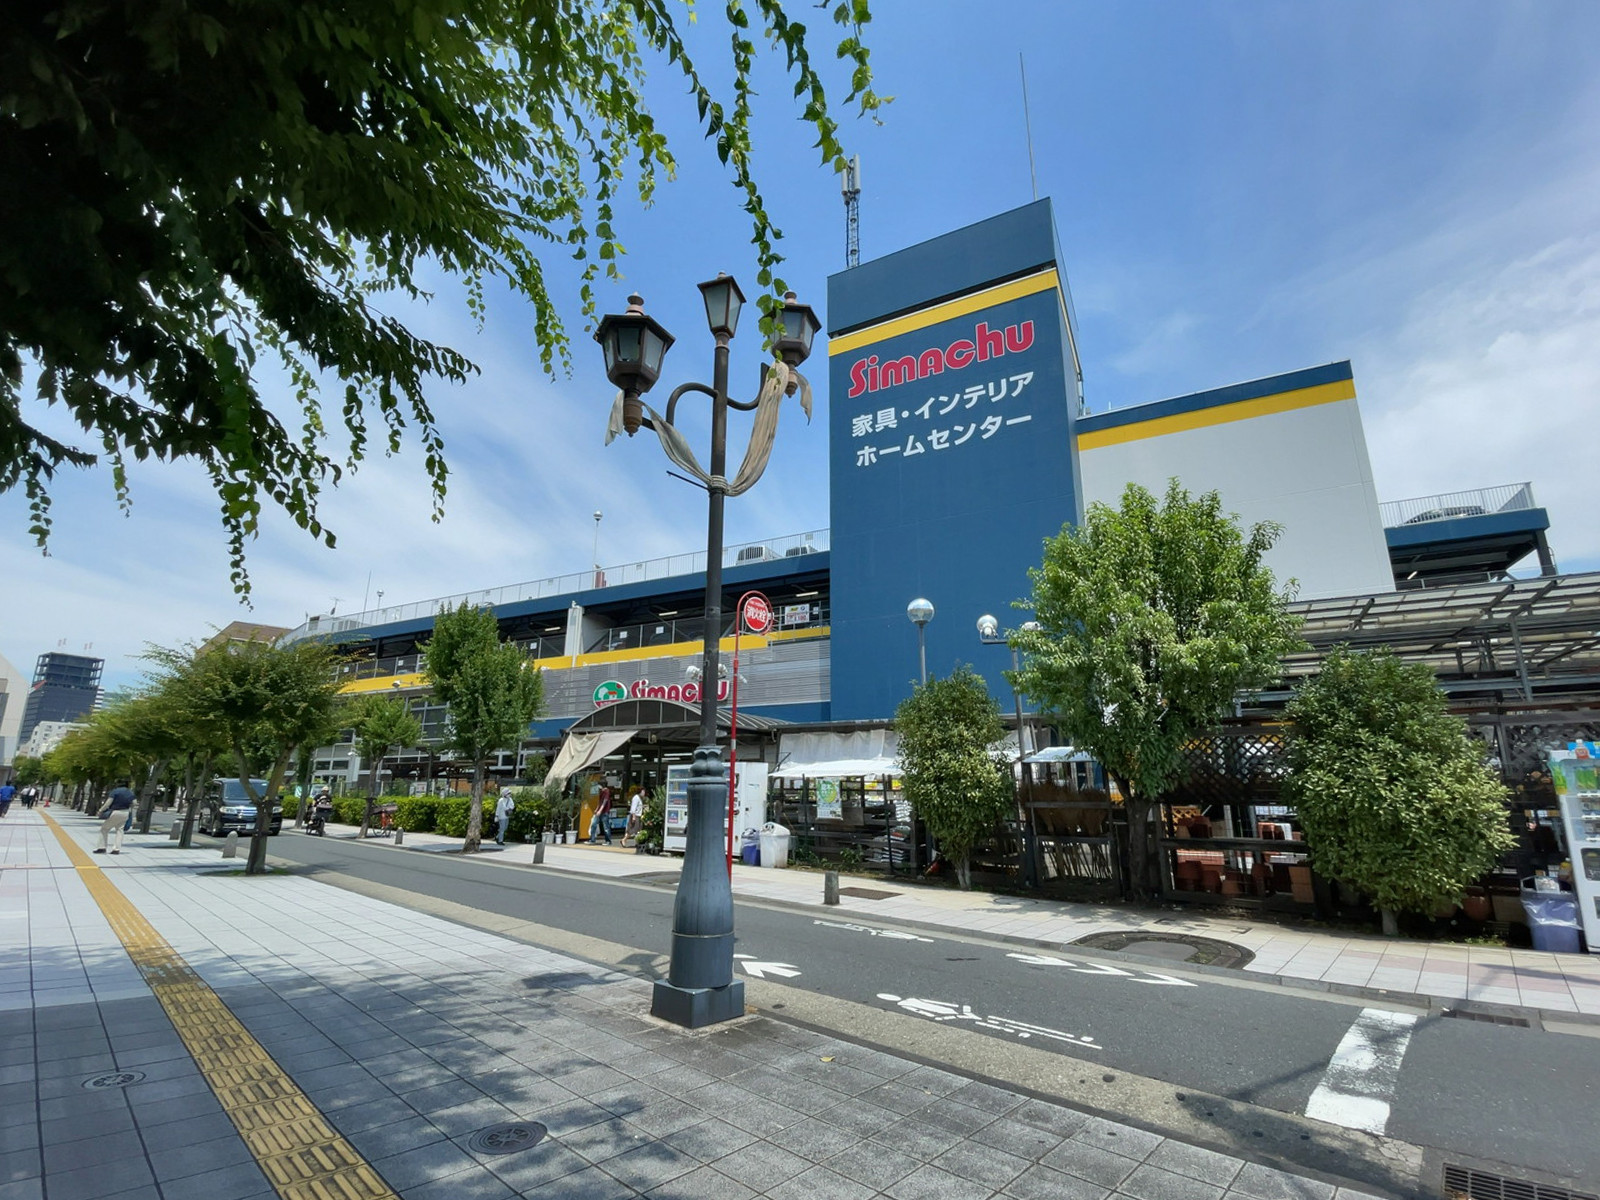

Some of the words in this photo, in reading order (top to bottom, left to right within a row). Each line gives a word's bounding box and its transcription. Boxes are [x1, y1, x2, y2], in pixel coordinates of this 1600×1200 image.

[852, 371, 1034, 438] 家具・インテリア
[856, 414, 1032, 467] ホームセンター
